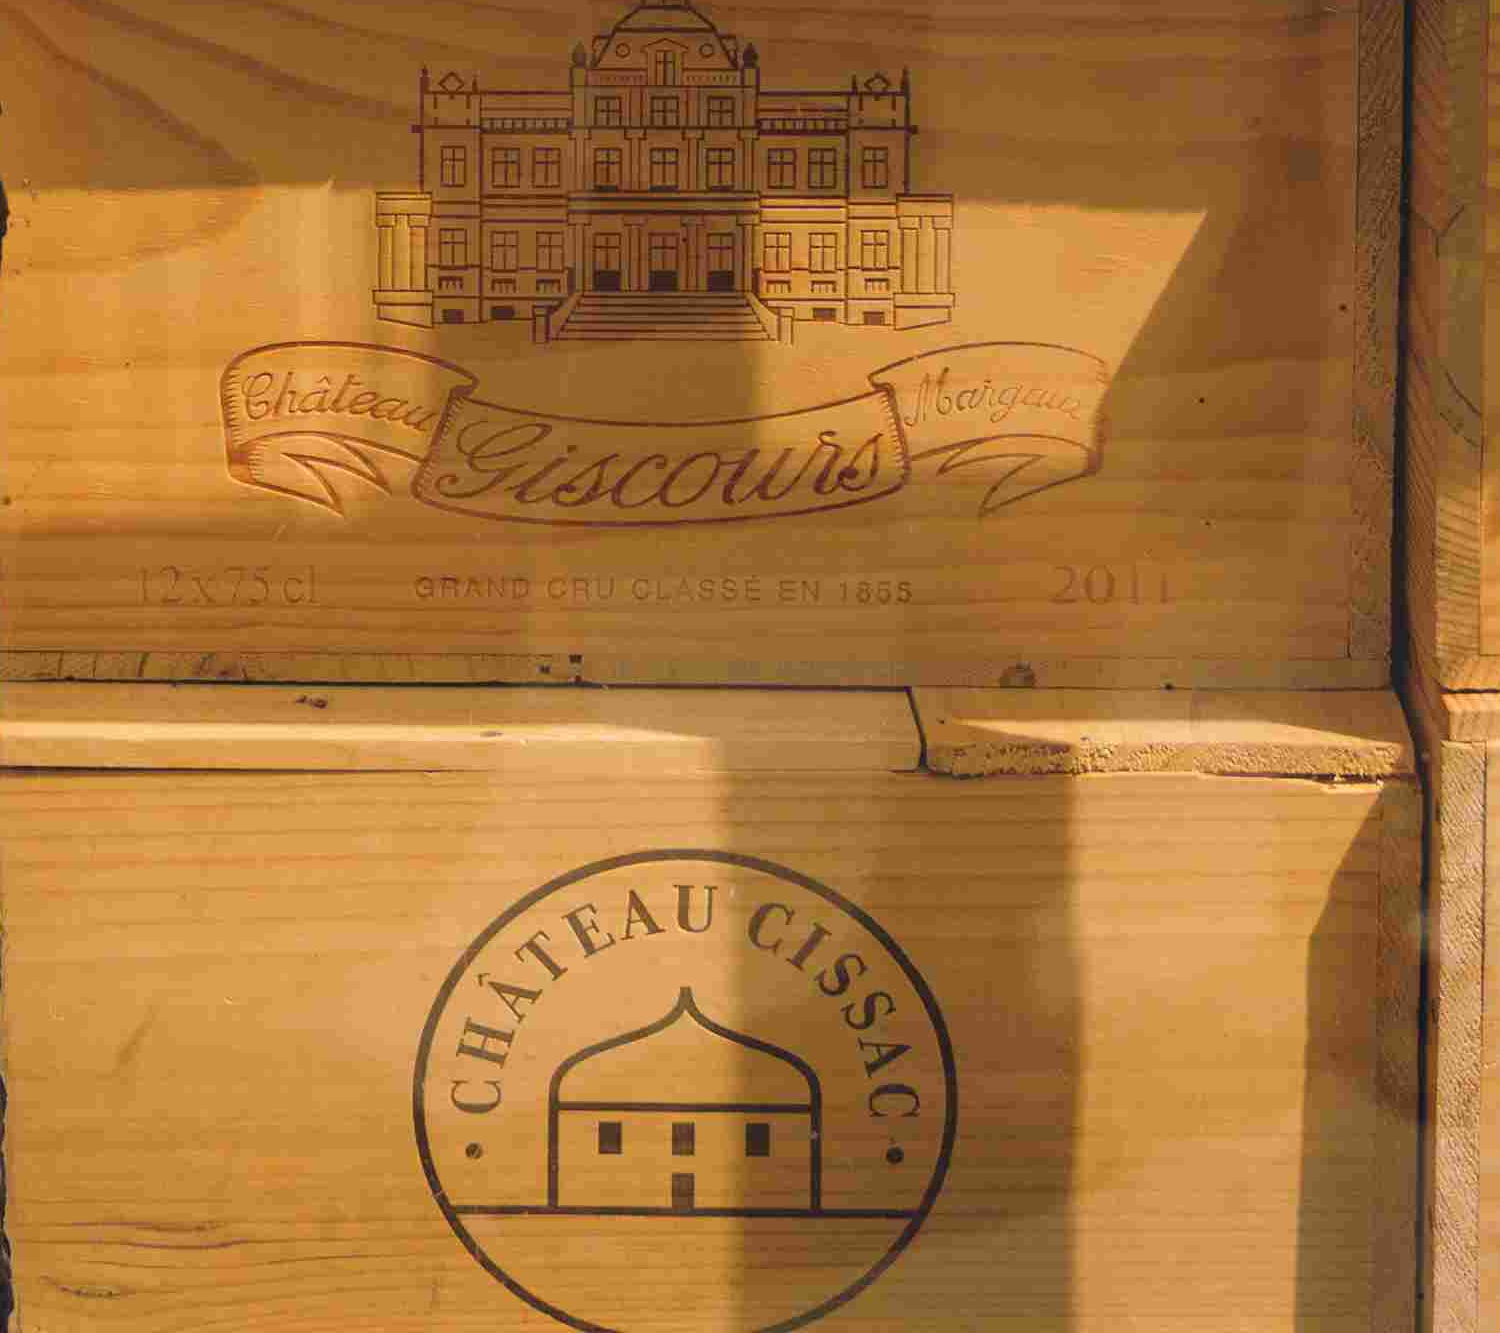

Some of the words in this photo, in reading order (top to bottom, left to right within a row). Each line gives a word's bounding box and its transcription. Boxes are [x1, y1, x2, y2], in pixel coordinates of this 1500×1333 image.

[242, 369, 439, 436] Château
[436, 420, 888, 509] Giscours
[414, 575, 530, 600] GRAND
[547, 575, 616, 601] CRU
[632, 570, 762, 602] CLASSÉ
[778, 579, 821, 603] EN
[839, 580, 913, 605] 1855
[448, 879, 722, 1118] CHÂTEAU
[744, 898, 923, 1123] CISSAC
